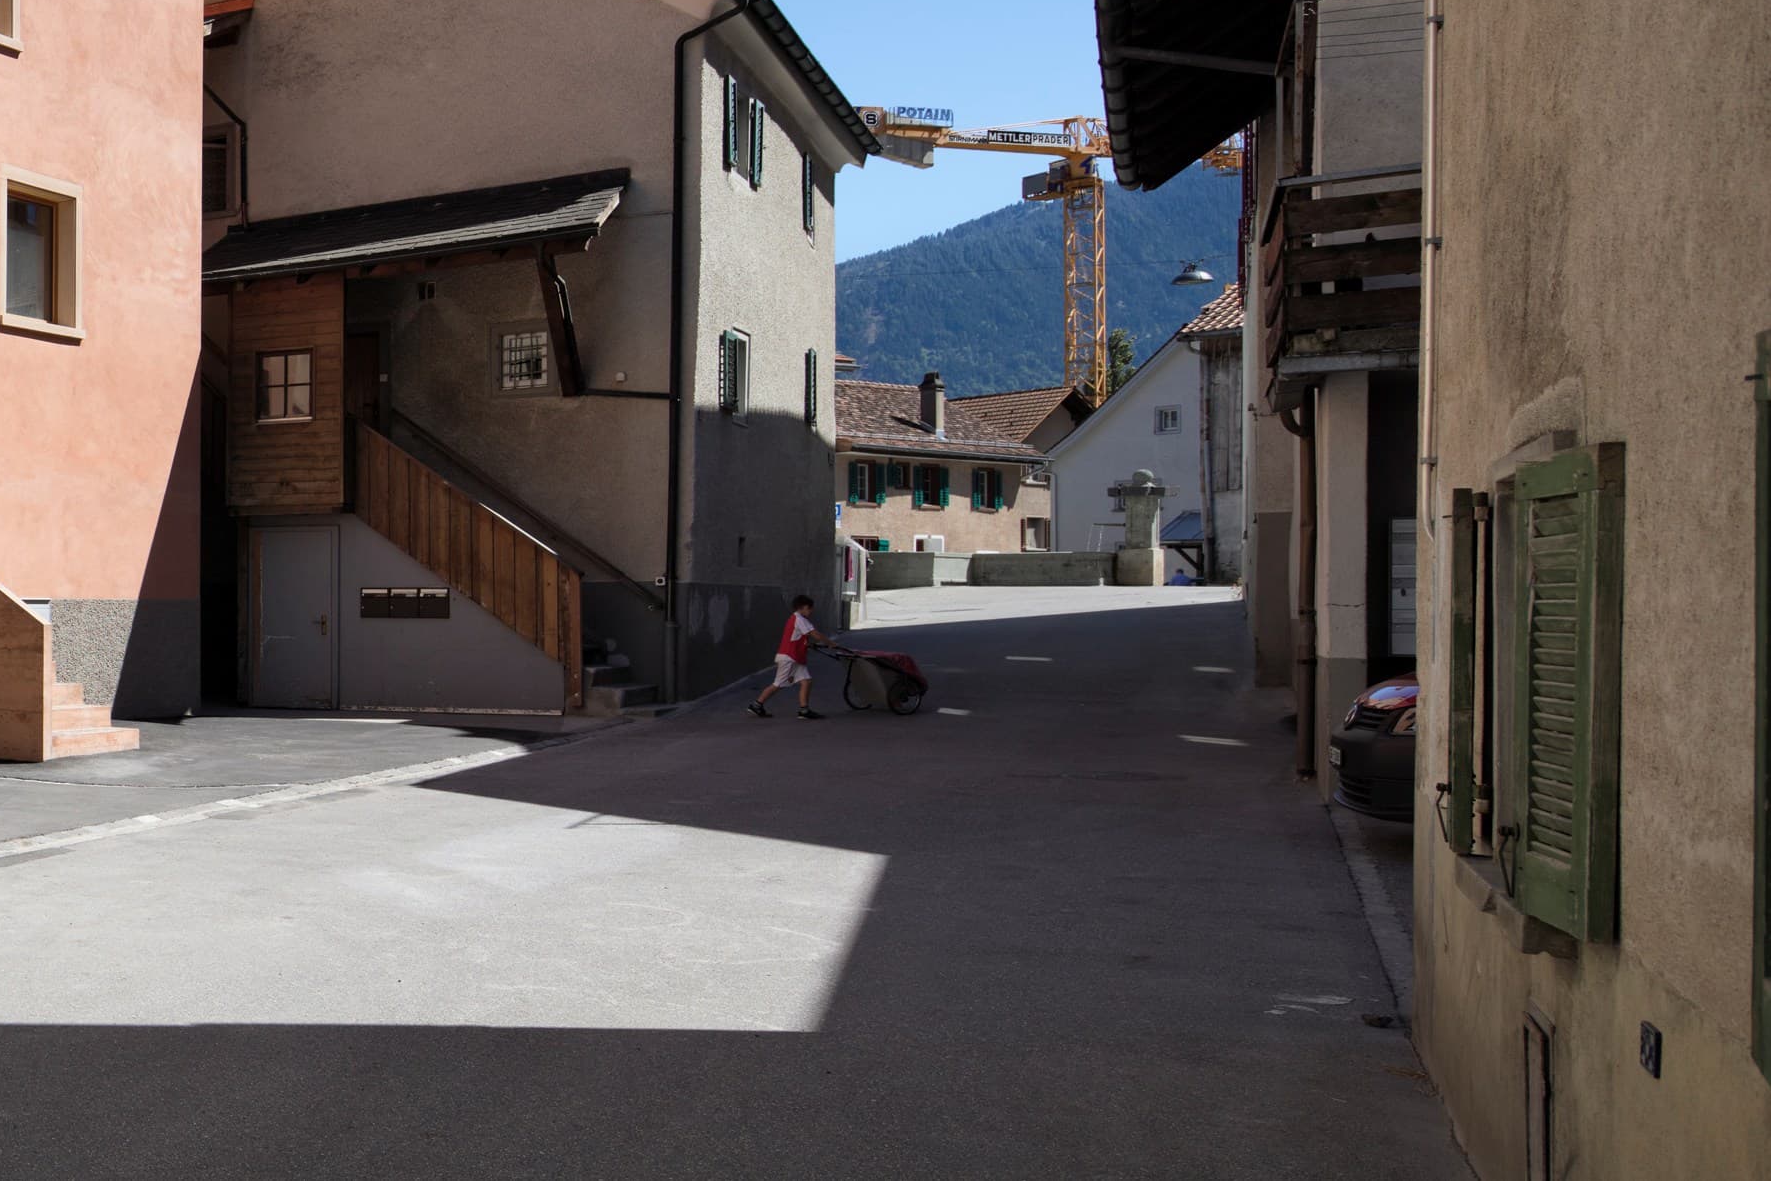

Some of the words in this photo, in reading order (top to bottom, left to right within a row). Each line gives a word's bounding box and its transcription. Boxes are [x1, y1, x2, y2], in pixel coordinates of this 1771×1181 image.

[897, 107, 951, 121] POTAIN
[989, 131, 1031, 143] METTLER
[1032, 134, 1069, 145] PRADER
